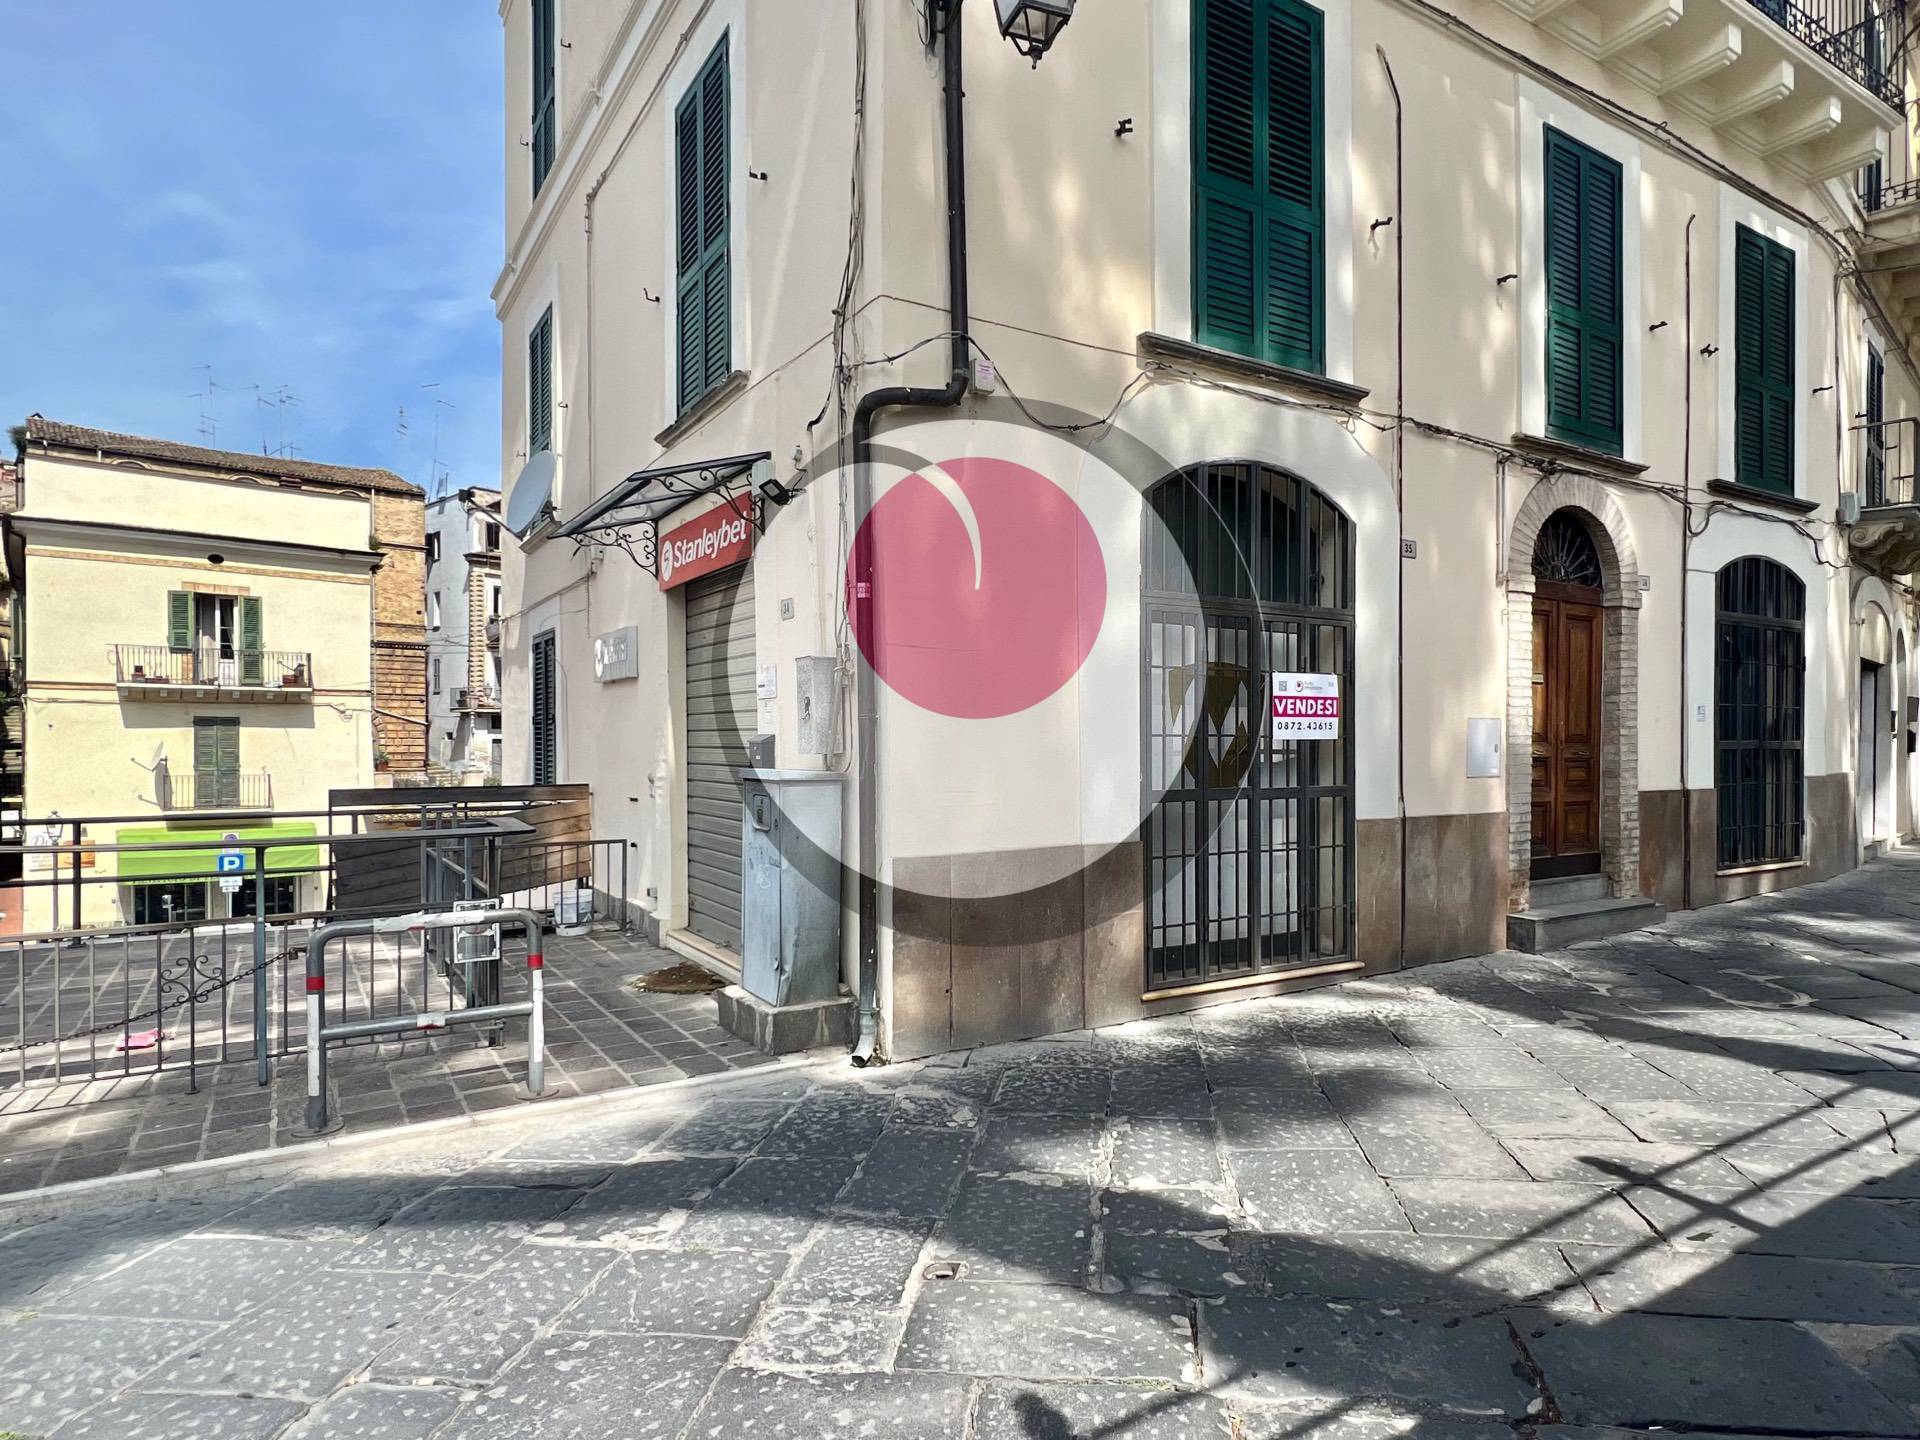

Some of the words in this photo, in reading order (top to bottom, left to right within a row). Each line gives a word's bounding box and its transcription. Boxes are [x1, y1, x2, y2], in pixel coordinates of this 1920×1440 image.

[673, 510, 748, 568] Stanleybet
[1404, 543, 1413, 554] 35
[1274, 698, 1337, 715] VENDESI
[1277, 721, 1333, 730] 0872.43615
[223, 857, 240, 871] P
